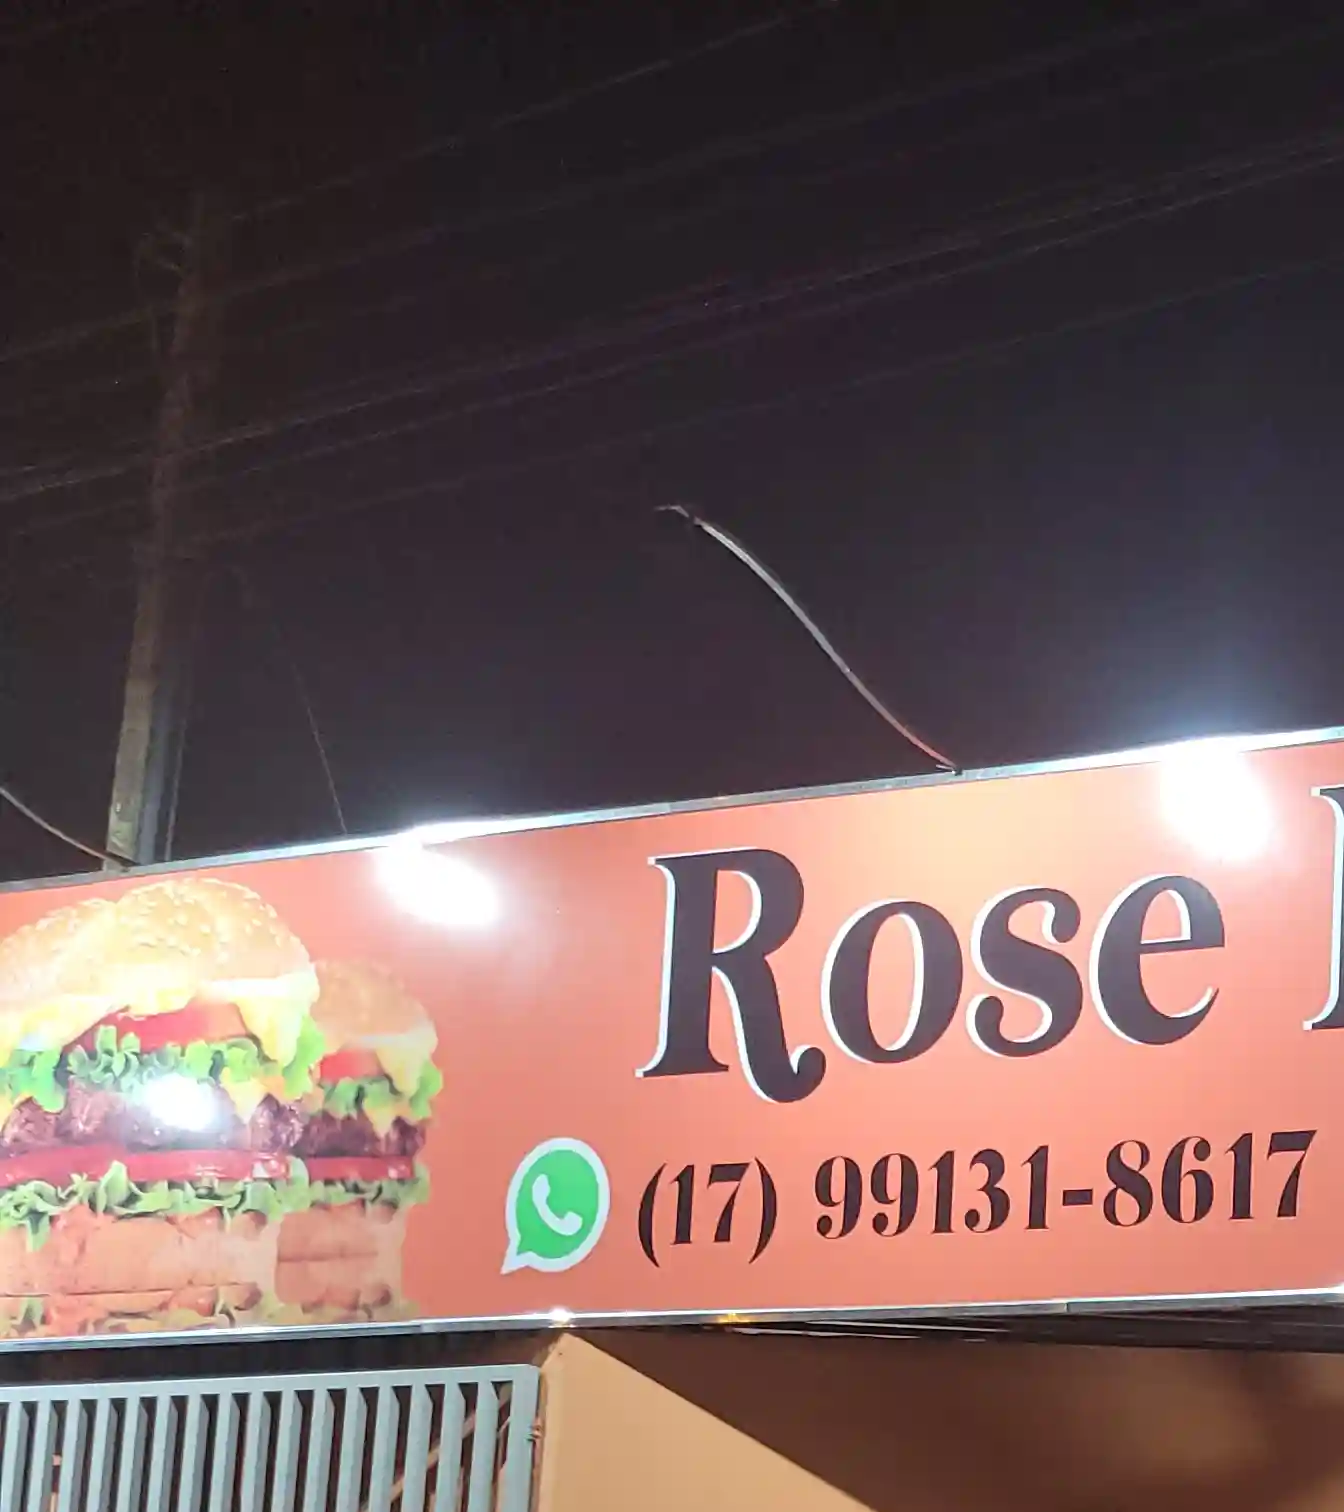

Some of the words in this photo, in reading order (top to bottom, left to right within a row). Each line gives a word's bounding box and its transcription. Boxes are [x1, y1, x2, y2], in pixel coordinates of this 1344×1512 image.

[635, 845, 1225, 1104] Rose
[637, 1158, 779, 1268] (17)
[814, 1129, 1318, 1240] 99131-8617
